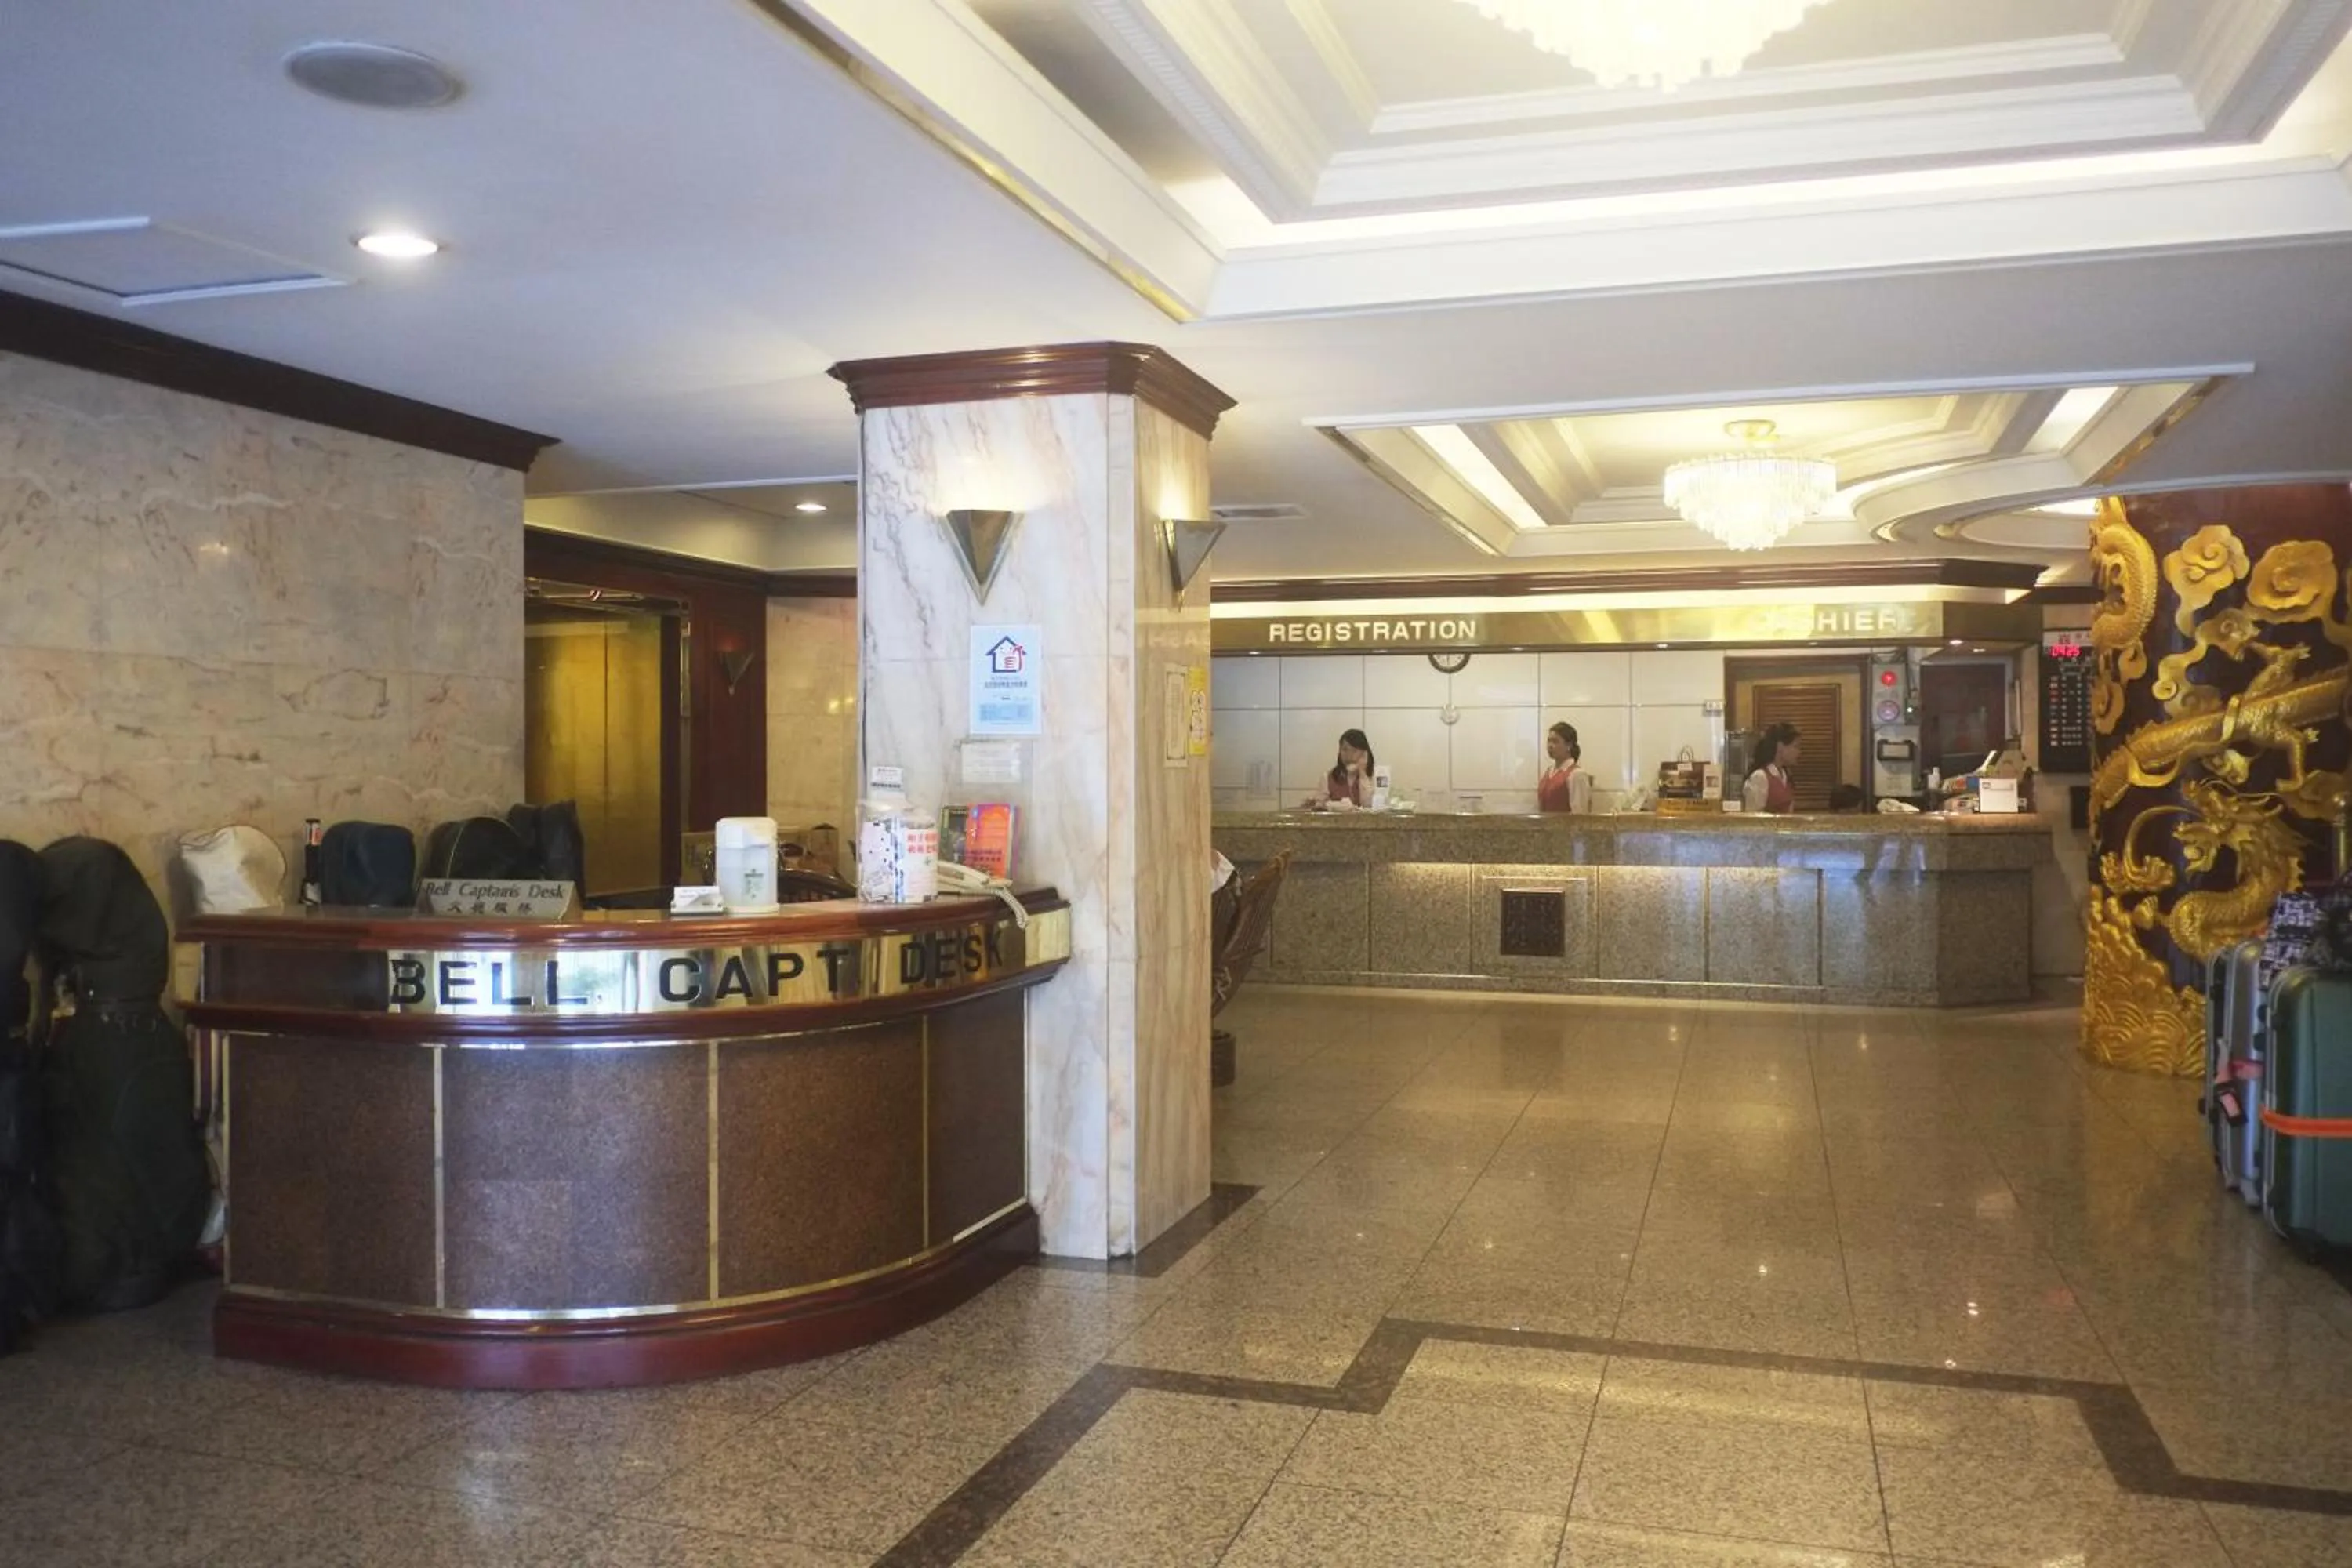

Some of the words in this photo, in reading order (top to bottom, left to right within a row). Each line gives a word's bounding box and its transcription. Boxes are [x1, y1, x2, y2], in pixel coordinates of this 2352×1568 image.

[1269, 620, 1476, 642] REGISTRATION
[426, 881, 451, 896] Bell
[528, 884, 564, 899] Desk
[391, 960, 588, 1005] BELL
[659, 949, 849, 1002] CAPT
[899, 926, 1003, 984] DESK
